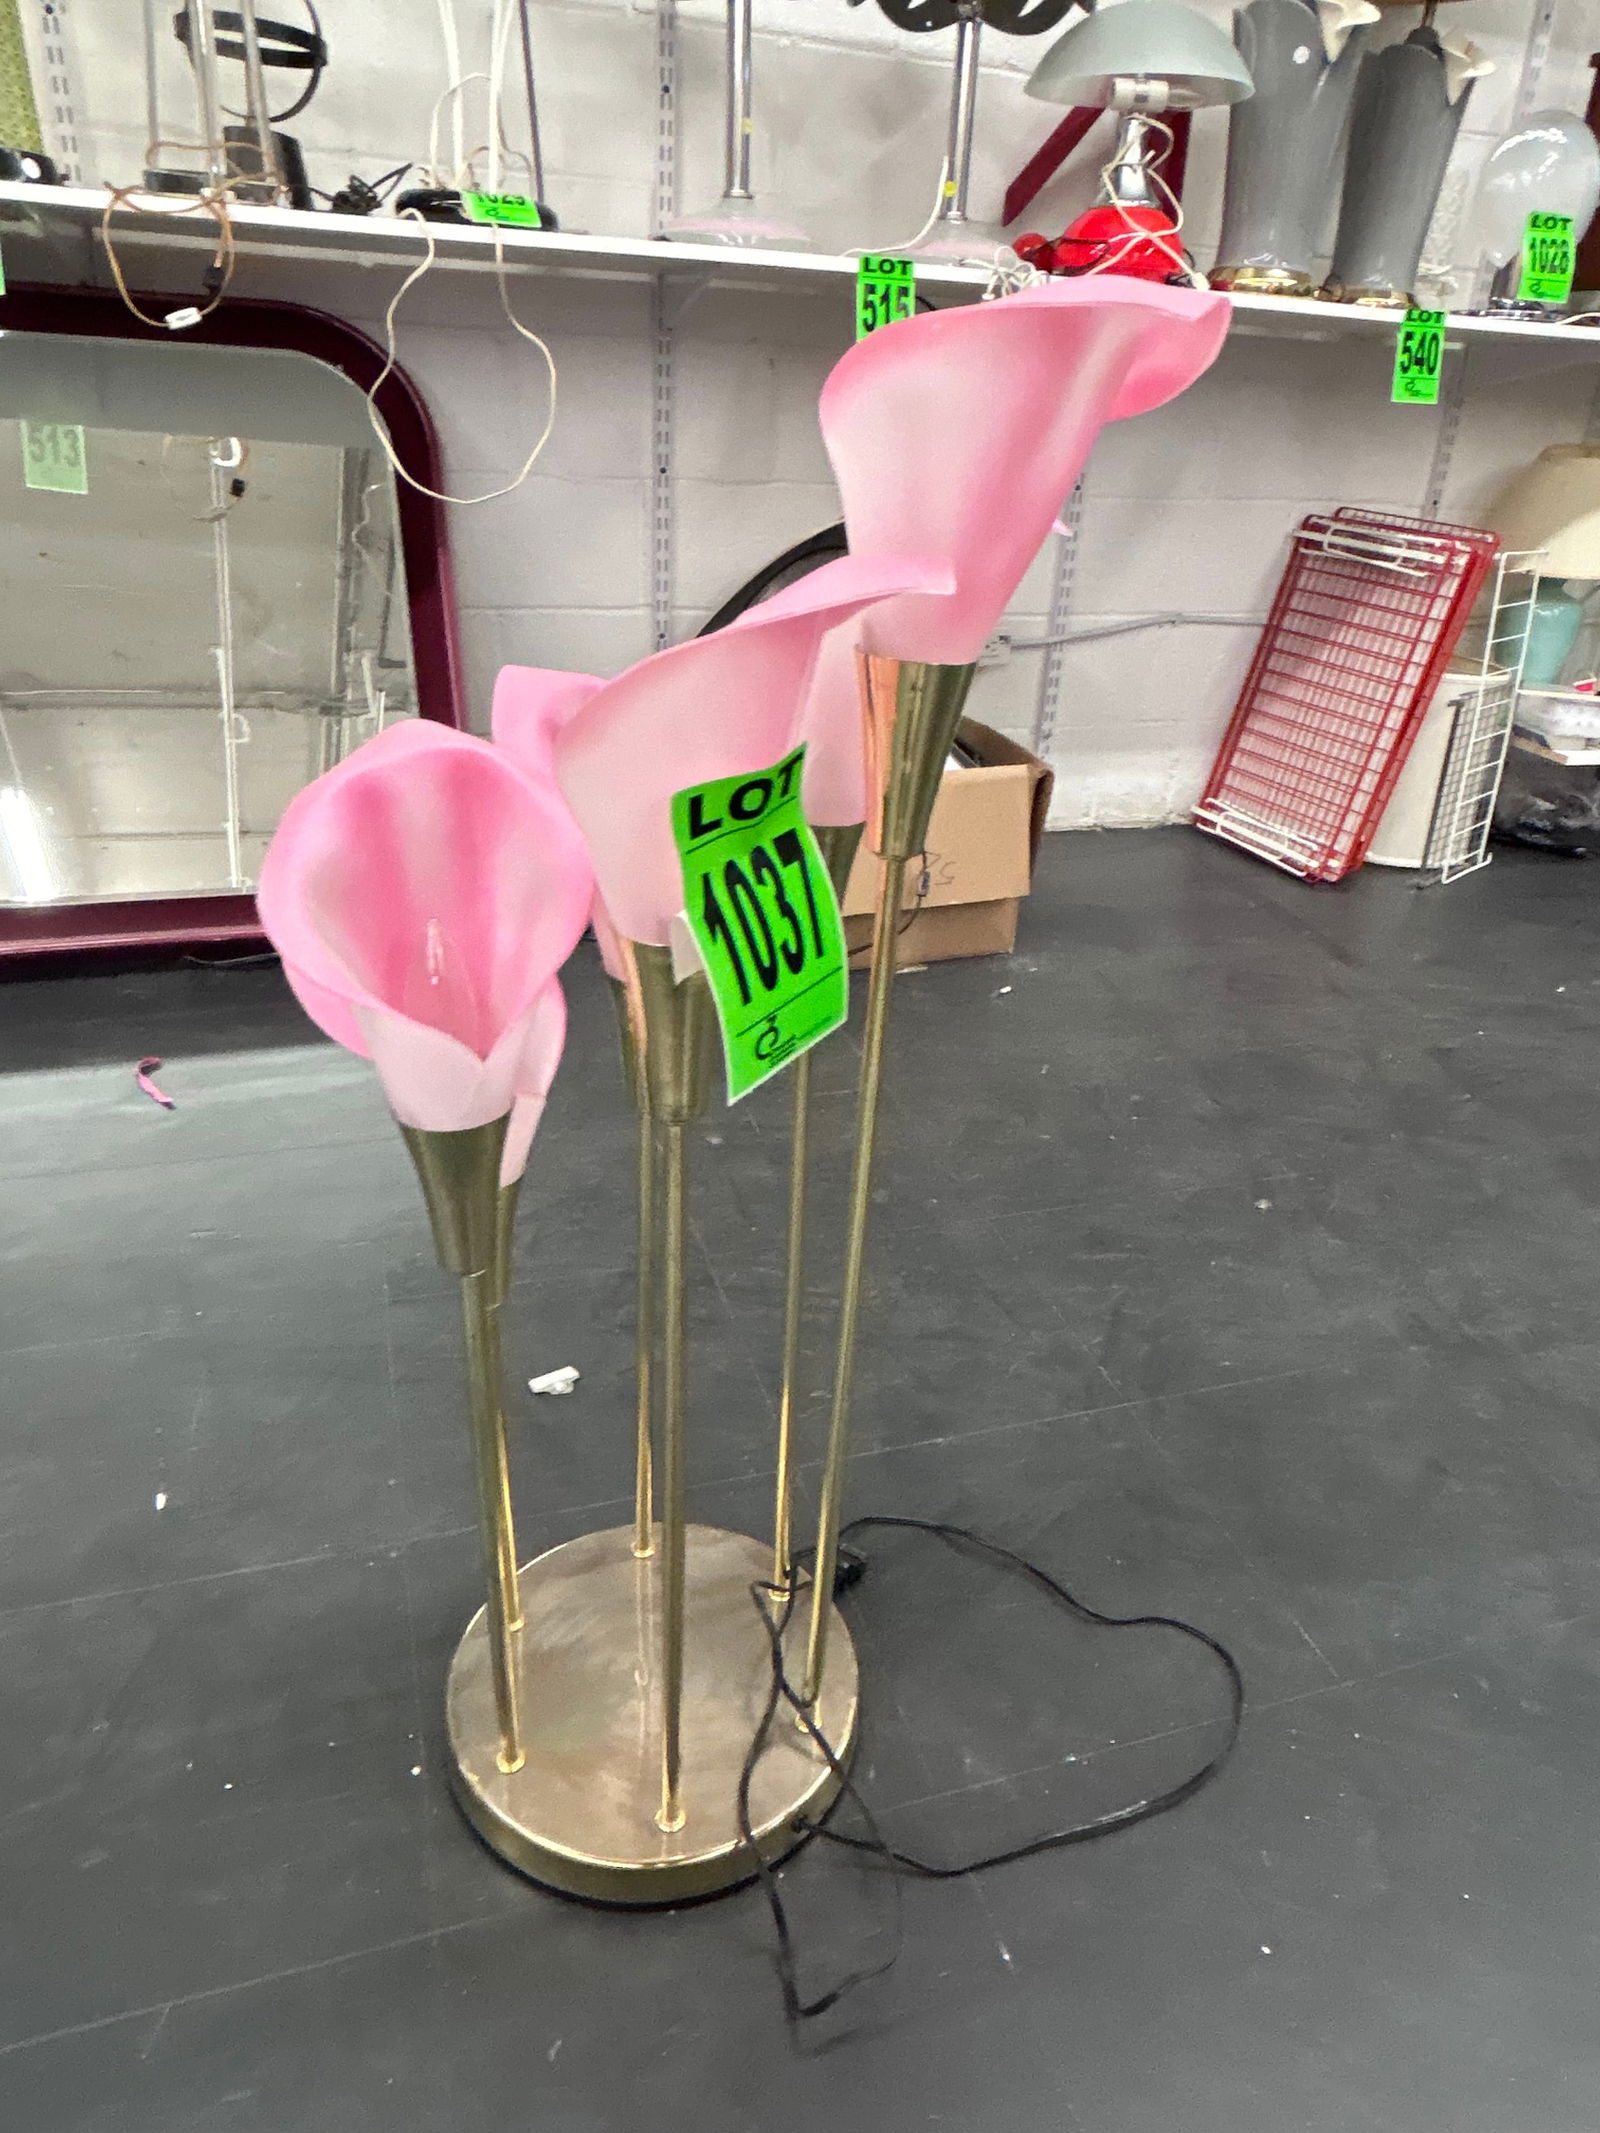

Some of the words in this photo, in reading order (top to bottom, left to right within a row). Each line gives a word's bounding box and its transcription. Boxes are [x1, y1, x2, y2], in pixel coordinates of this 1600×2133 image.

[1531, 214, 1573, 231] LOT
[863, 256, 913, 276] LOT
[862, 283, 911, 333] 515
[1406, 308, 1445, 324] LOT
[1400, 330, 1441, 376] 540
[689, 751, 805, 840] LOT
[702, 827, 824, 1006] 1037
